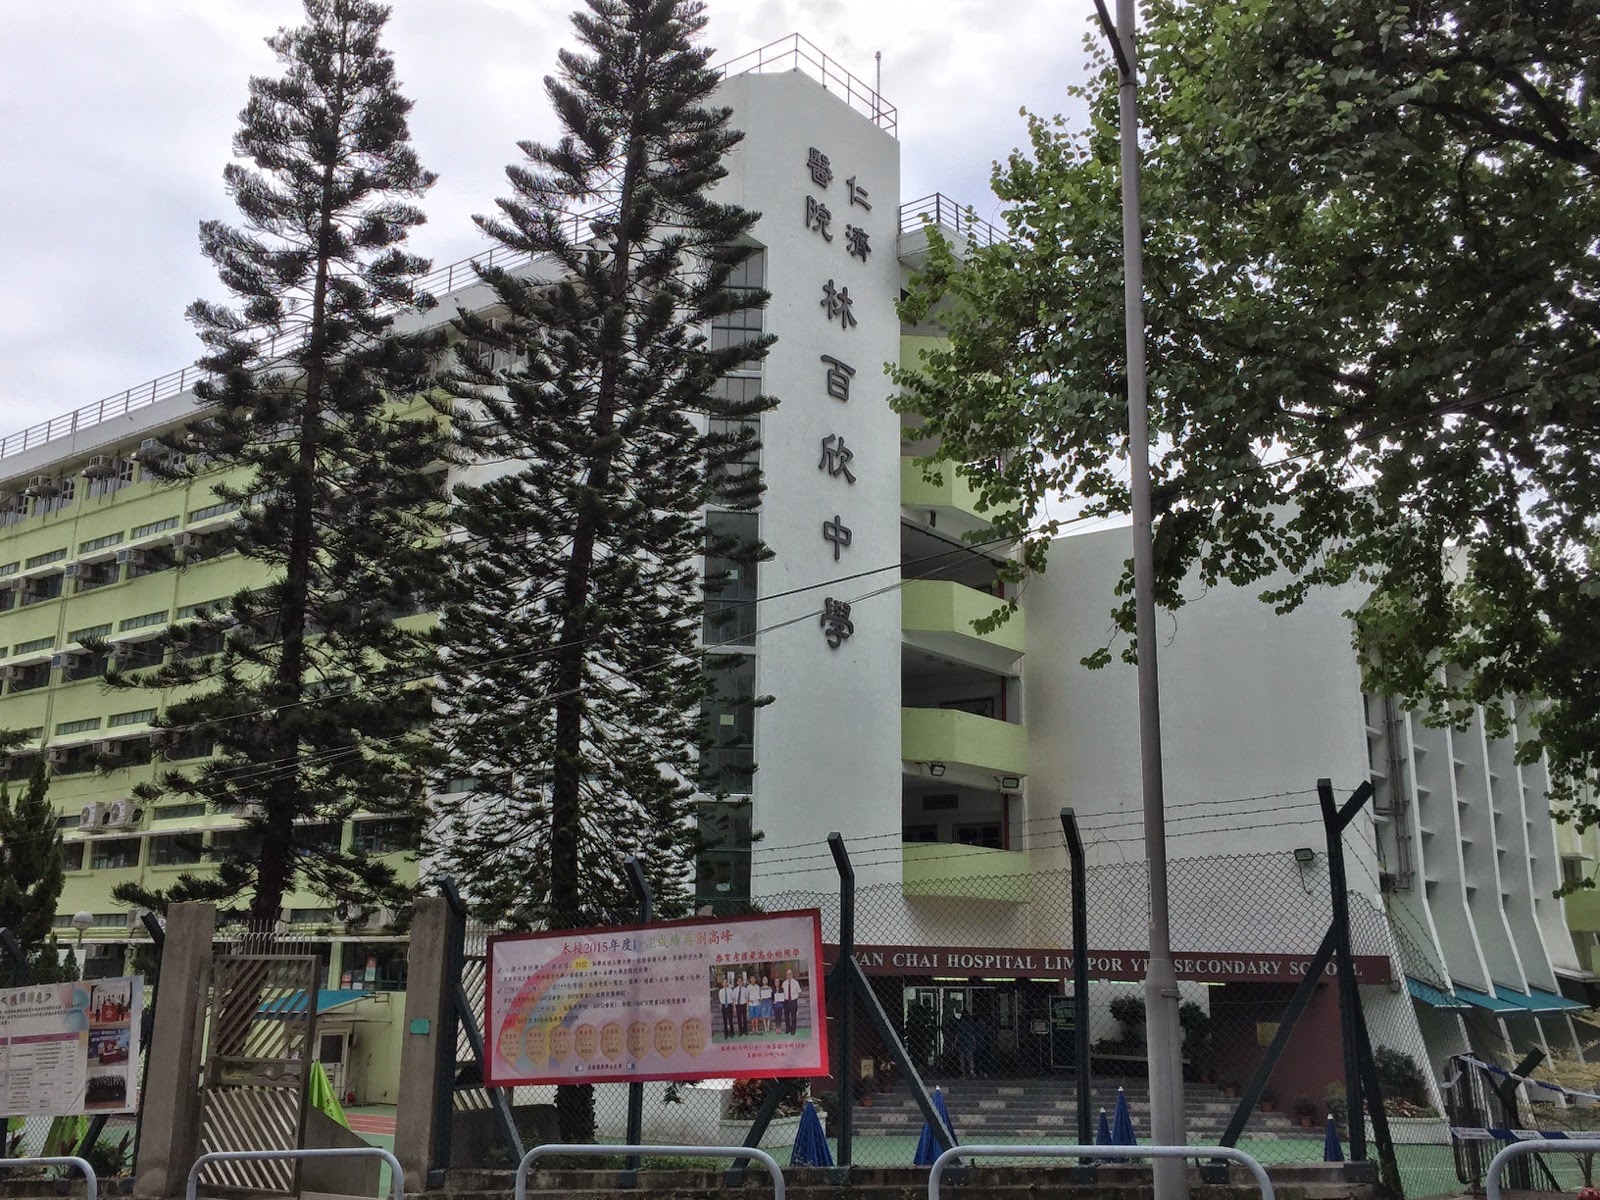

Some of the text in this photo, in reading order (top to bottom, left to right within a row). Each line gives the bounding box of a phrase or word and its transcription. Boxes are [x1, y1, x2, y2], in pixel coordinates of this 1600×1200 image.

[806, 146, 834, 242] 醫院
[845, 174, 872, 263] 仁濟
[818, 278, 858, 650] 林百欣中學
[892, 953, 939, 968] CHAI
[946, 953, 1037, 970] HOSPITAL
[1087, 956, 1124, 972] POR
[1173, 958, 1282, 976] SECONDARY
[1289, 961, 1363, 977] SCOL
